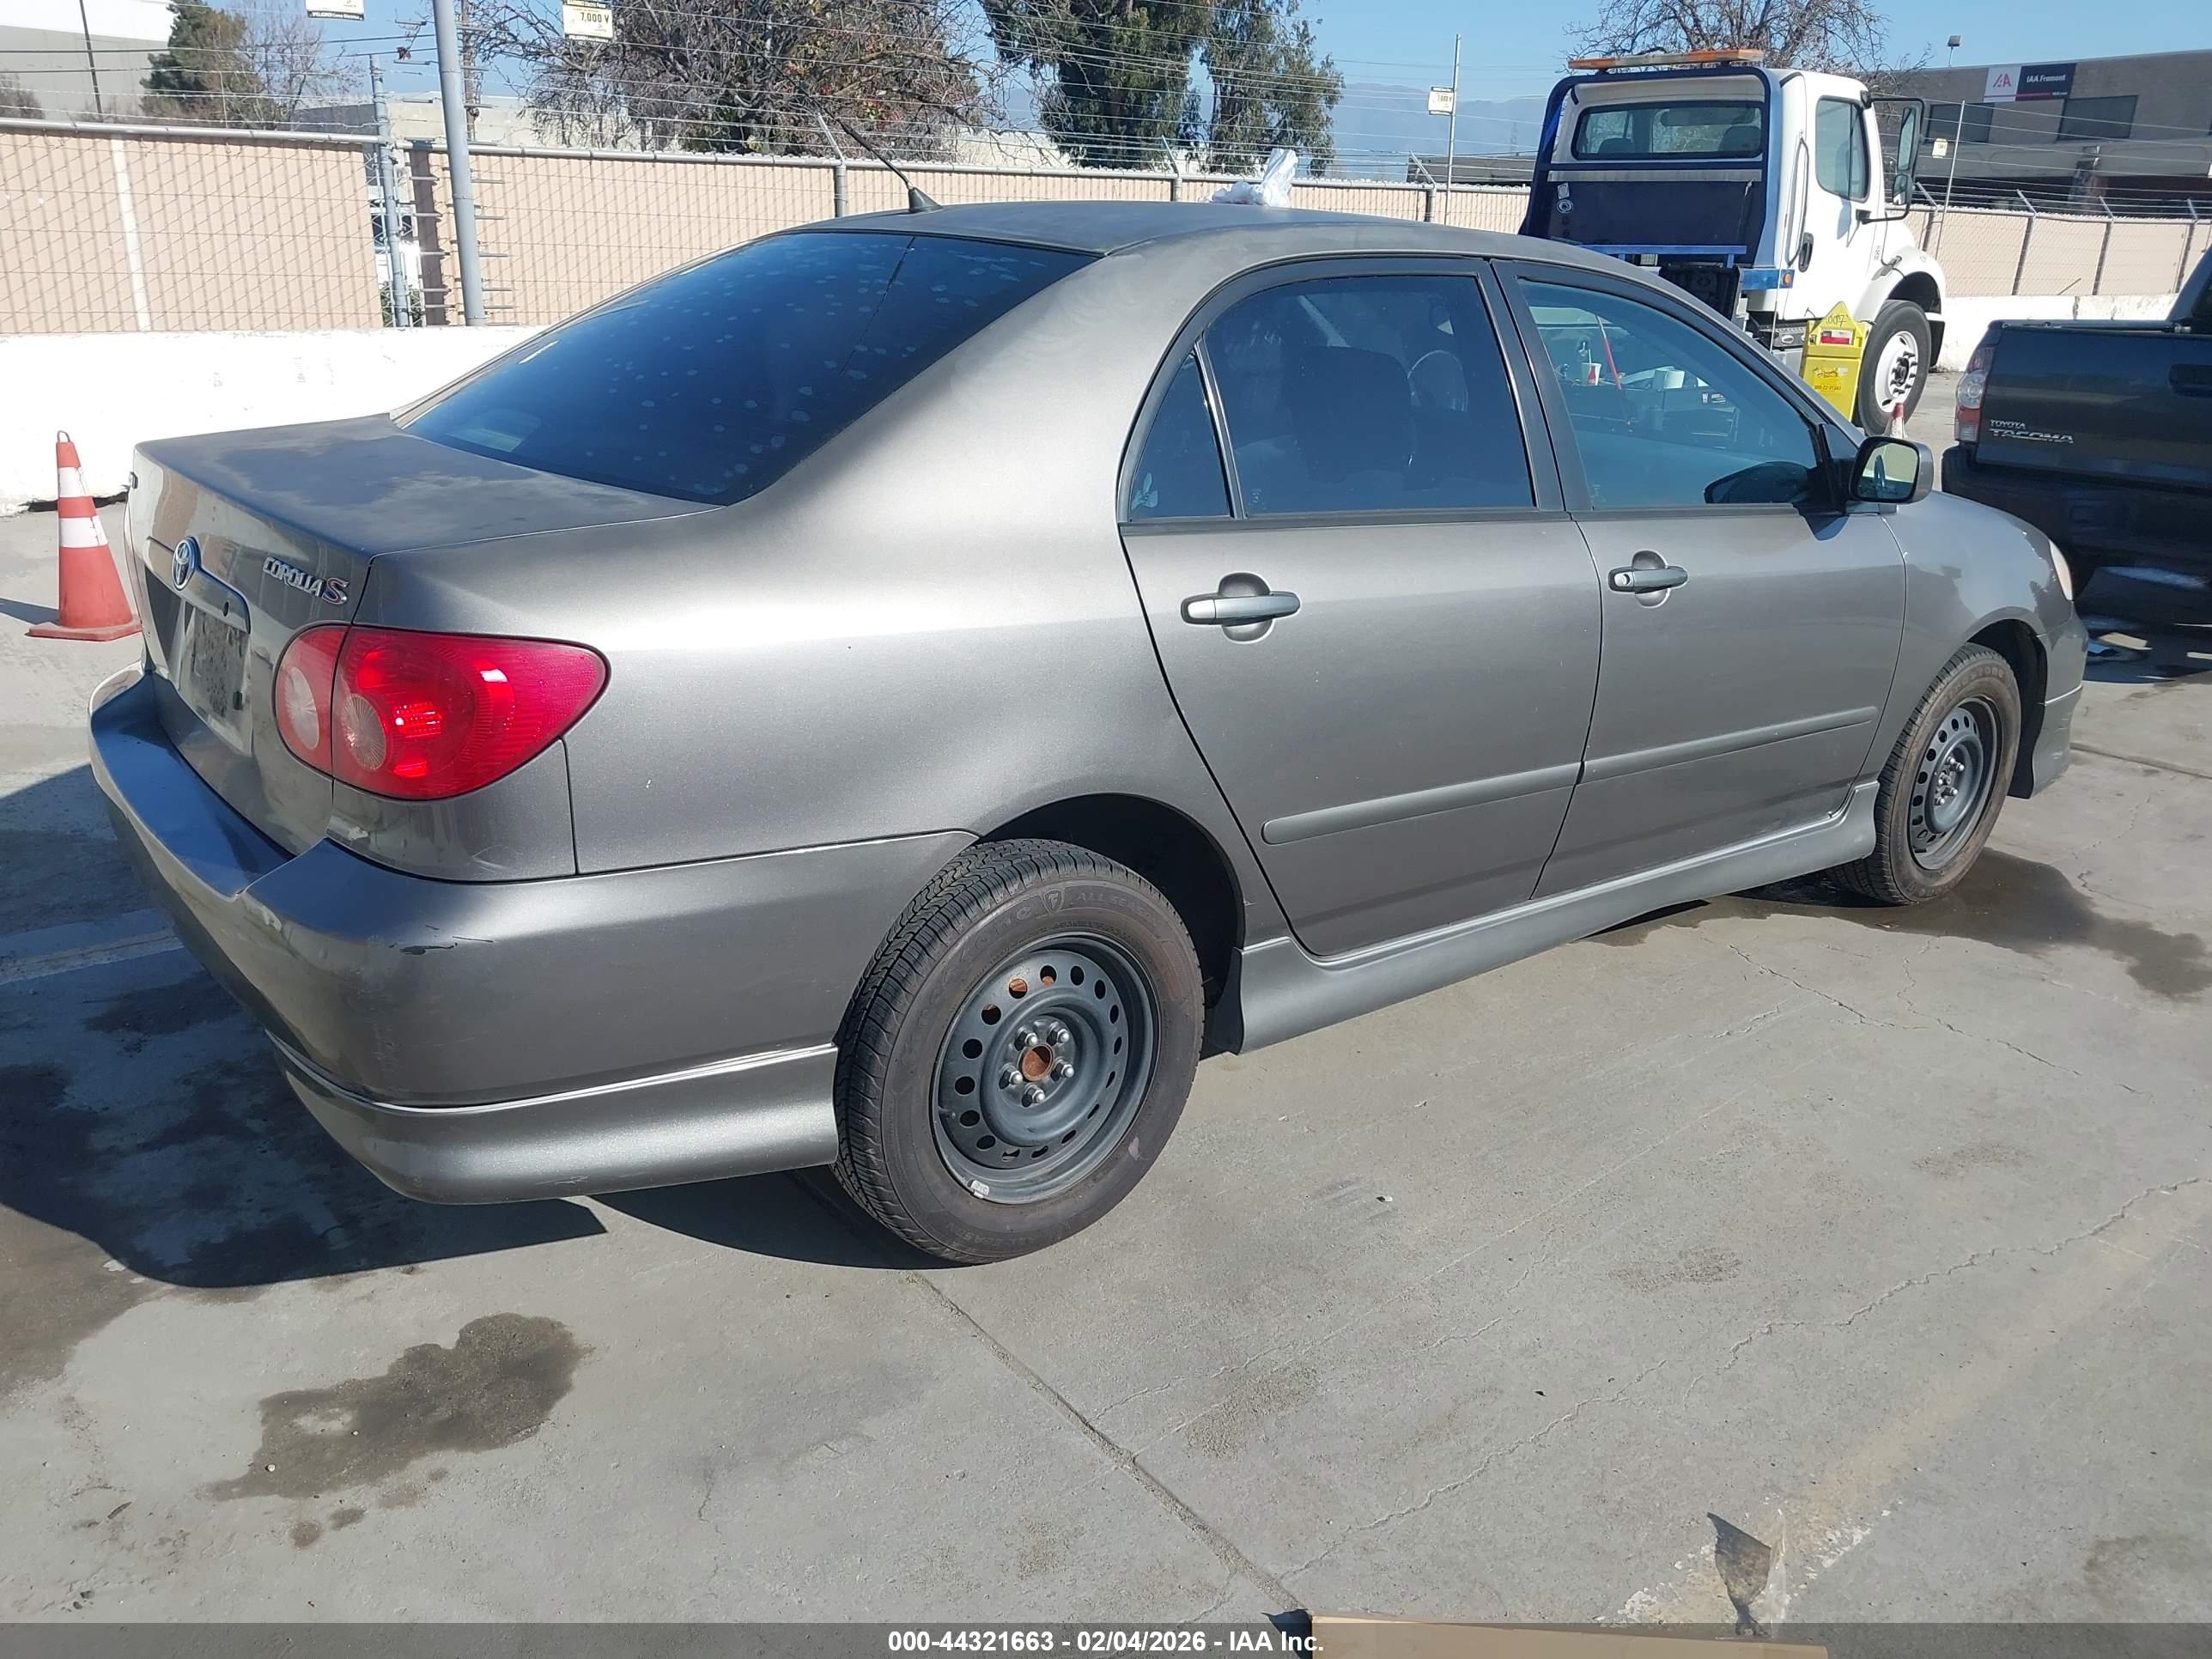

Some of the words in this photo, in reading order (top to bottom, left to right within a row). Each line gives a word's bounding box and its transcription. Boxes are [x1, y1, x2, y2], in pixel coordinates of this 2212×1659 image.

[580, 12, 602, 22] 7,000
[605, 15, 609, 23] V
[2027, 75, 2039, 83] IAA
[2039, 74, 2066, 82] Fremont
[1990, 419, 2026, 430] TOYOTA
[1989, 428, 2074, 444] TACOMA
[263, 556, 323, 597] COROLLA
[321, 577, 349, 605] S
